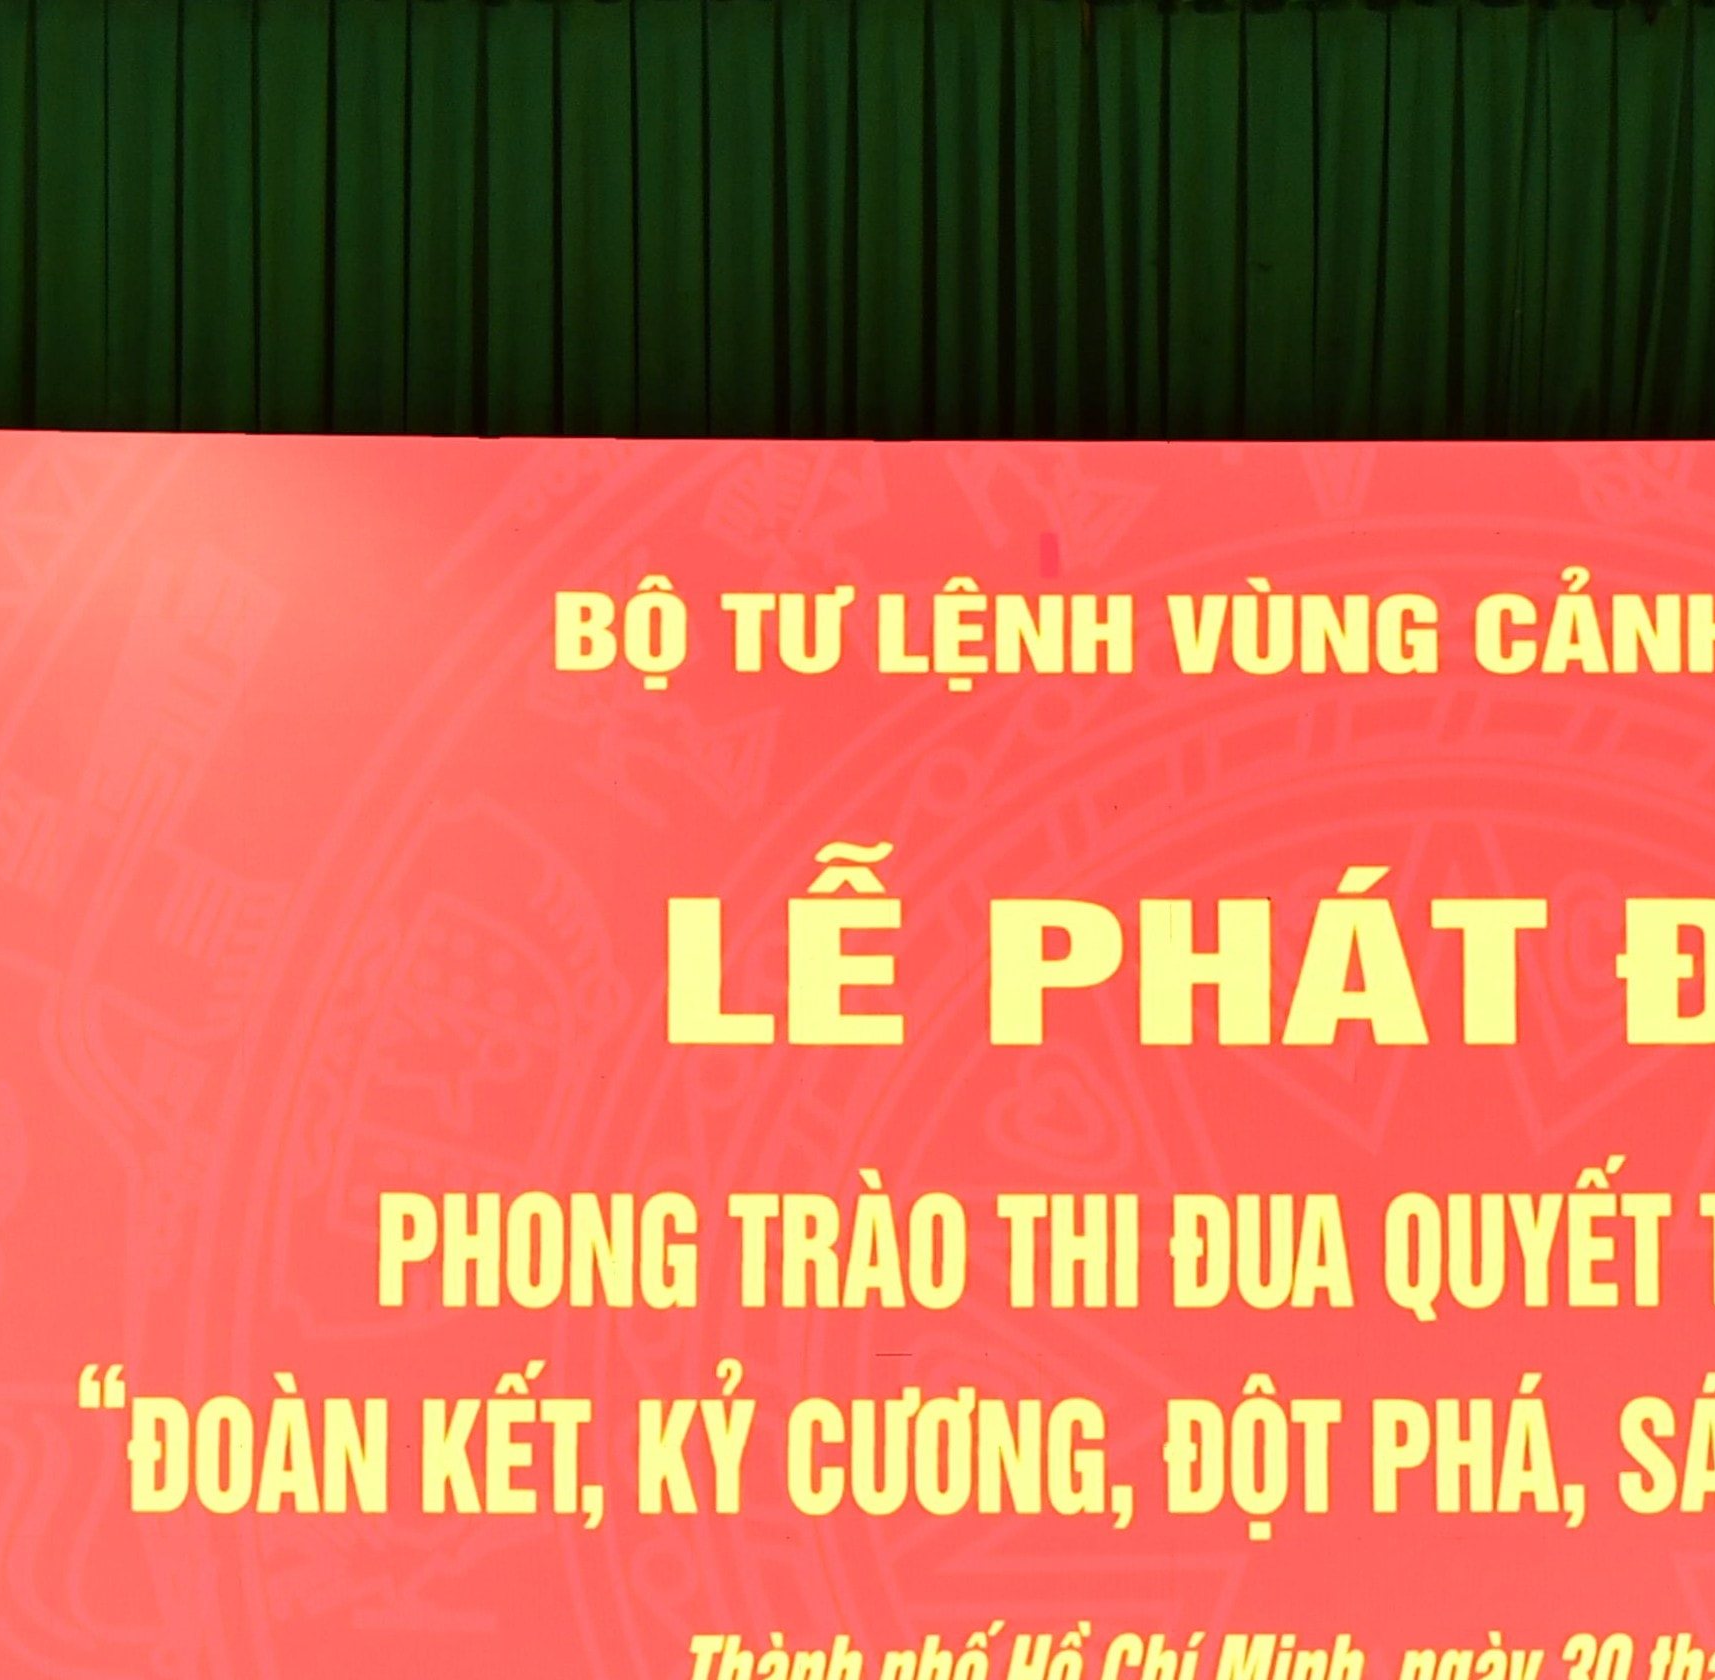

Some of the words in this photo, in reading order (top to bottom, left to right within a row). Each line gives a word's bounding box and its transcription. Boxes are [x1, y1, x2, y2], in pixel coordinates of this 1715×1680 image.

[555, 575, 687, 690] BỘ
[721, 585, 855, 674] TƯ
[878, 576, 1133, 692] LỆNH
[1167, 577, 1438, 675] VÙNG
[667, 842, 904, 1045] LỄ
[990, 866, 1548, 1045] PHÁT
[379, 1191, 698, 1309] PHONG
[728, 1168, 967, 1310] TRÀO
[997, 1193, 1139, 1308] THI
[1169, 1194, 1354, 1309] ĐUA
[1385, 1154, 1672, 1322] QUYẾT
[78, 1363, 388, 1514] “ĐOÀN
[422, 1359, 604, 1529] KẾT,
[638, 1358, 756, 1514] KỶ
[787, 1386, 1133, 1529] CƯƠNG,
[1163, 1373, 1342, 1541] ĐỘT
[1372, 1372, 1585, 1528] PHÁ,
